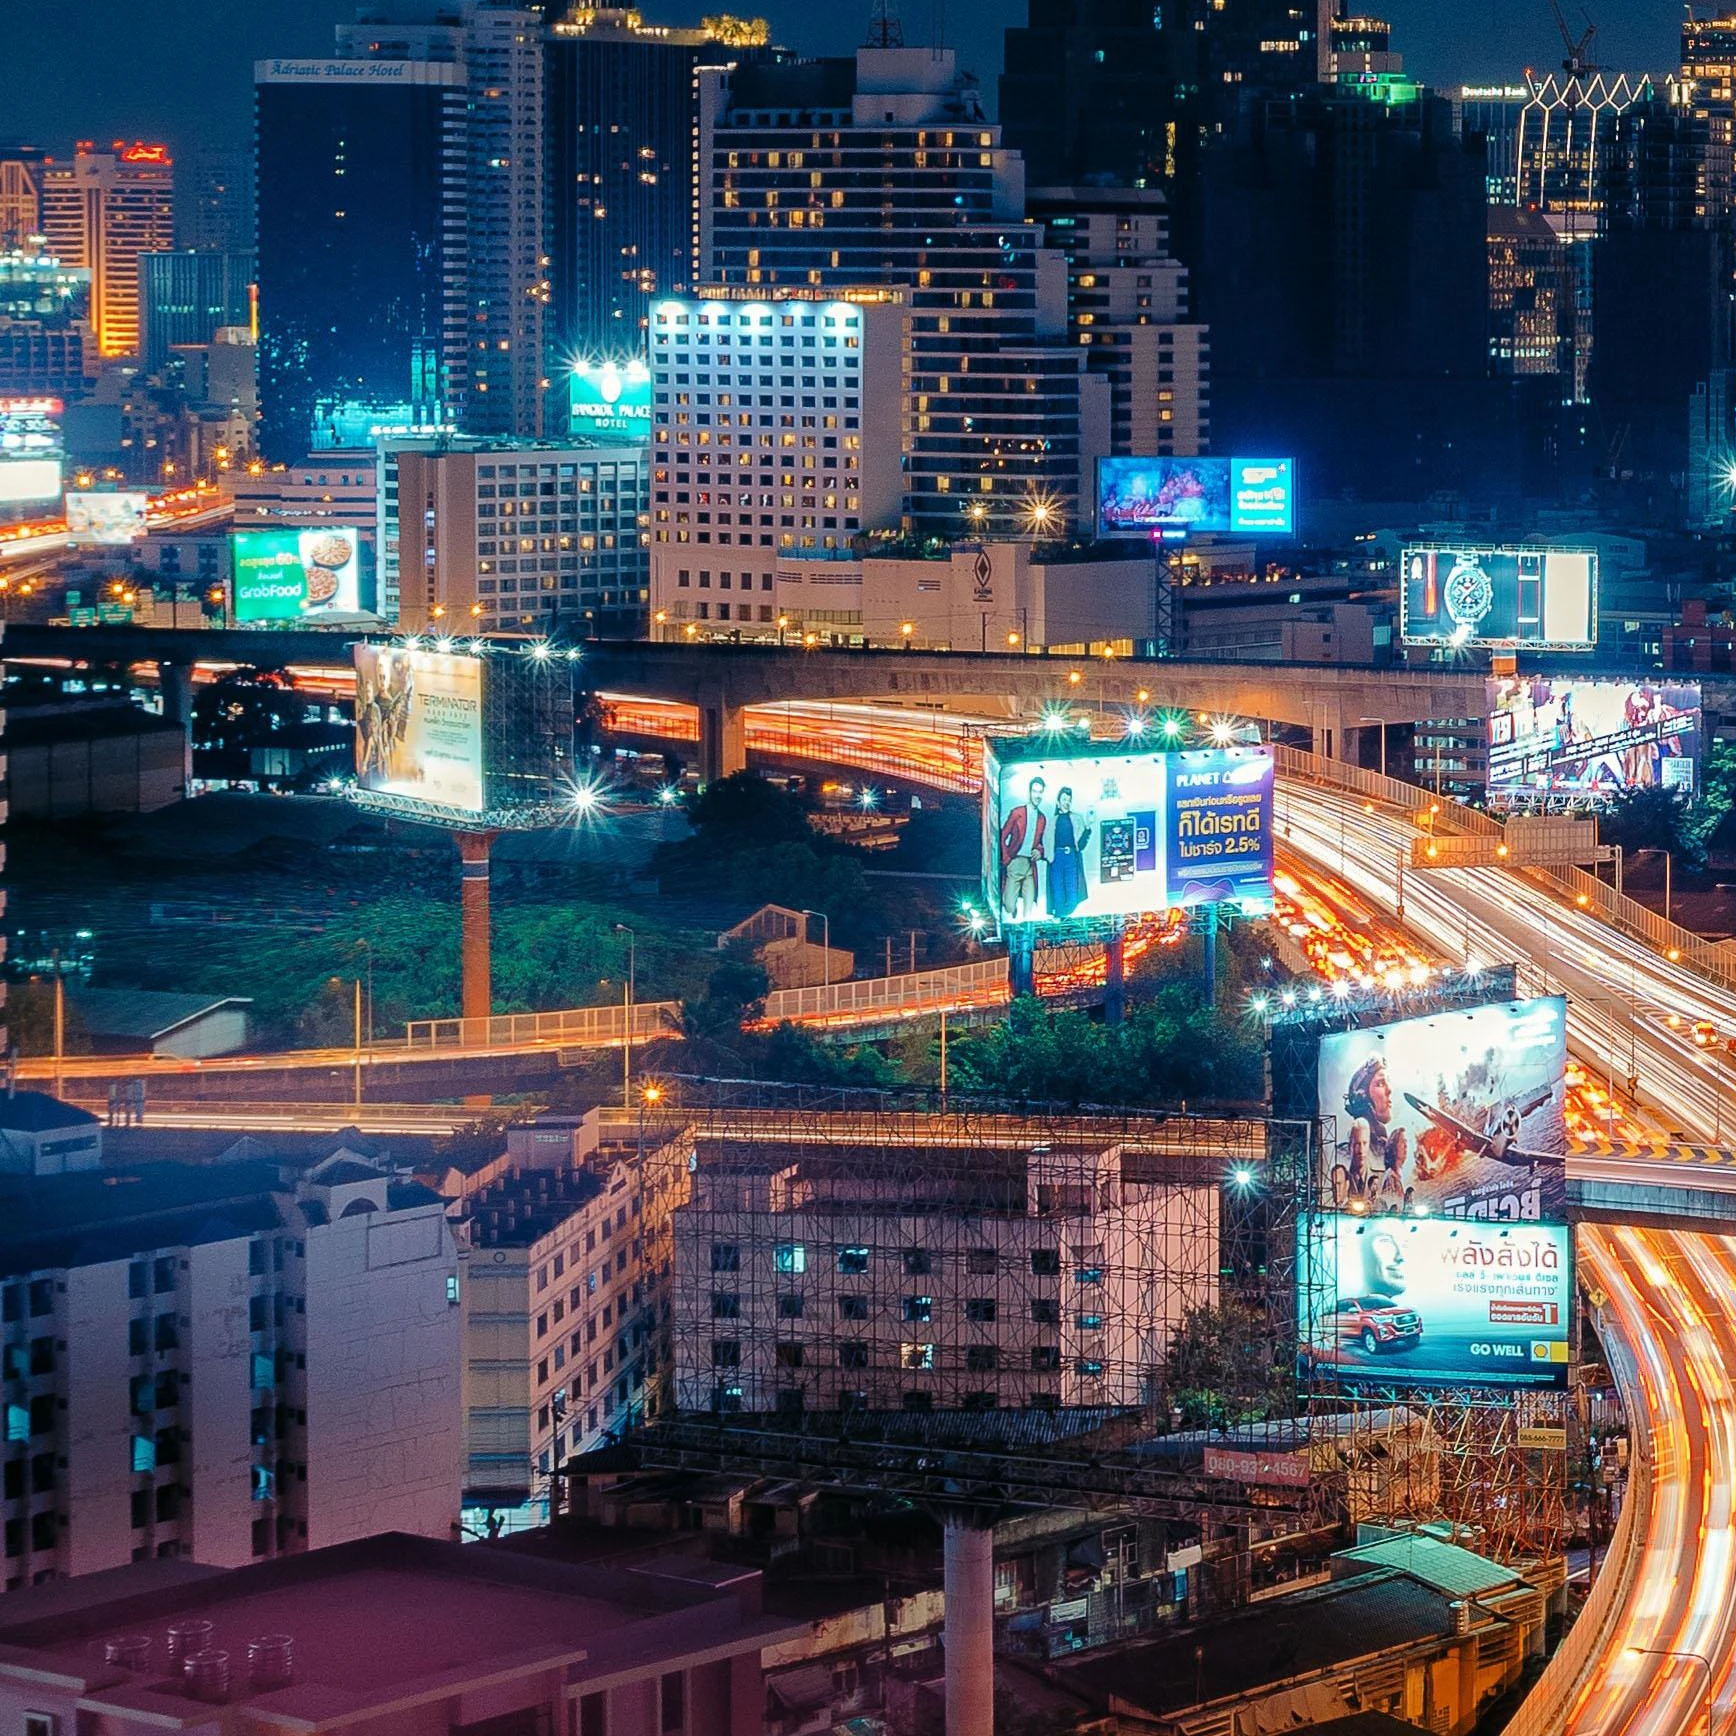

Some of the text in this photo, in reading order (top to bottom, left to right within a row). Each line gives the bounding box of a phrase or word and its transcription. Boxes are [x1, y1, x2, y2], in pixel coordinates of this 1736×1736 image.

[270, 60, 405, 78] Adriatic Palace Hotel
[595, 418, 628, 429] HOTEL
[240, 581, 302, 599] GrabFood
[417, 693, 477, 713] TERMINATOR
[1176, 771, 1220, 788] PLANET
[1470, 1343, 1525, 1357] GO WELL
